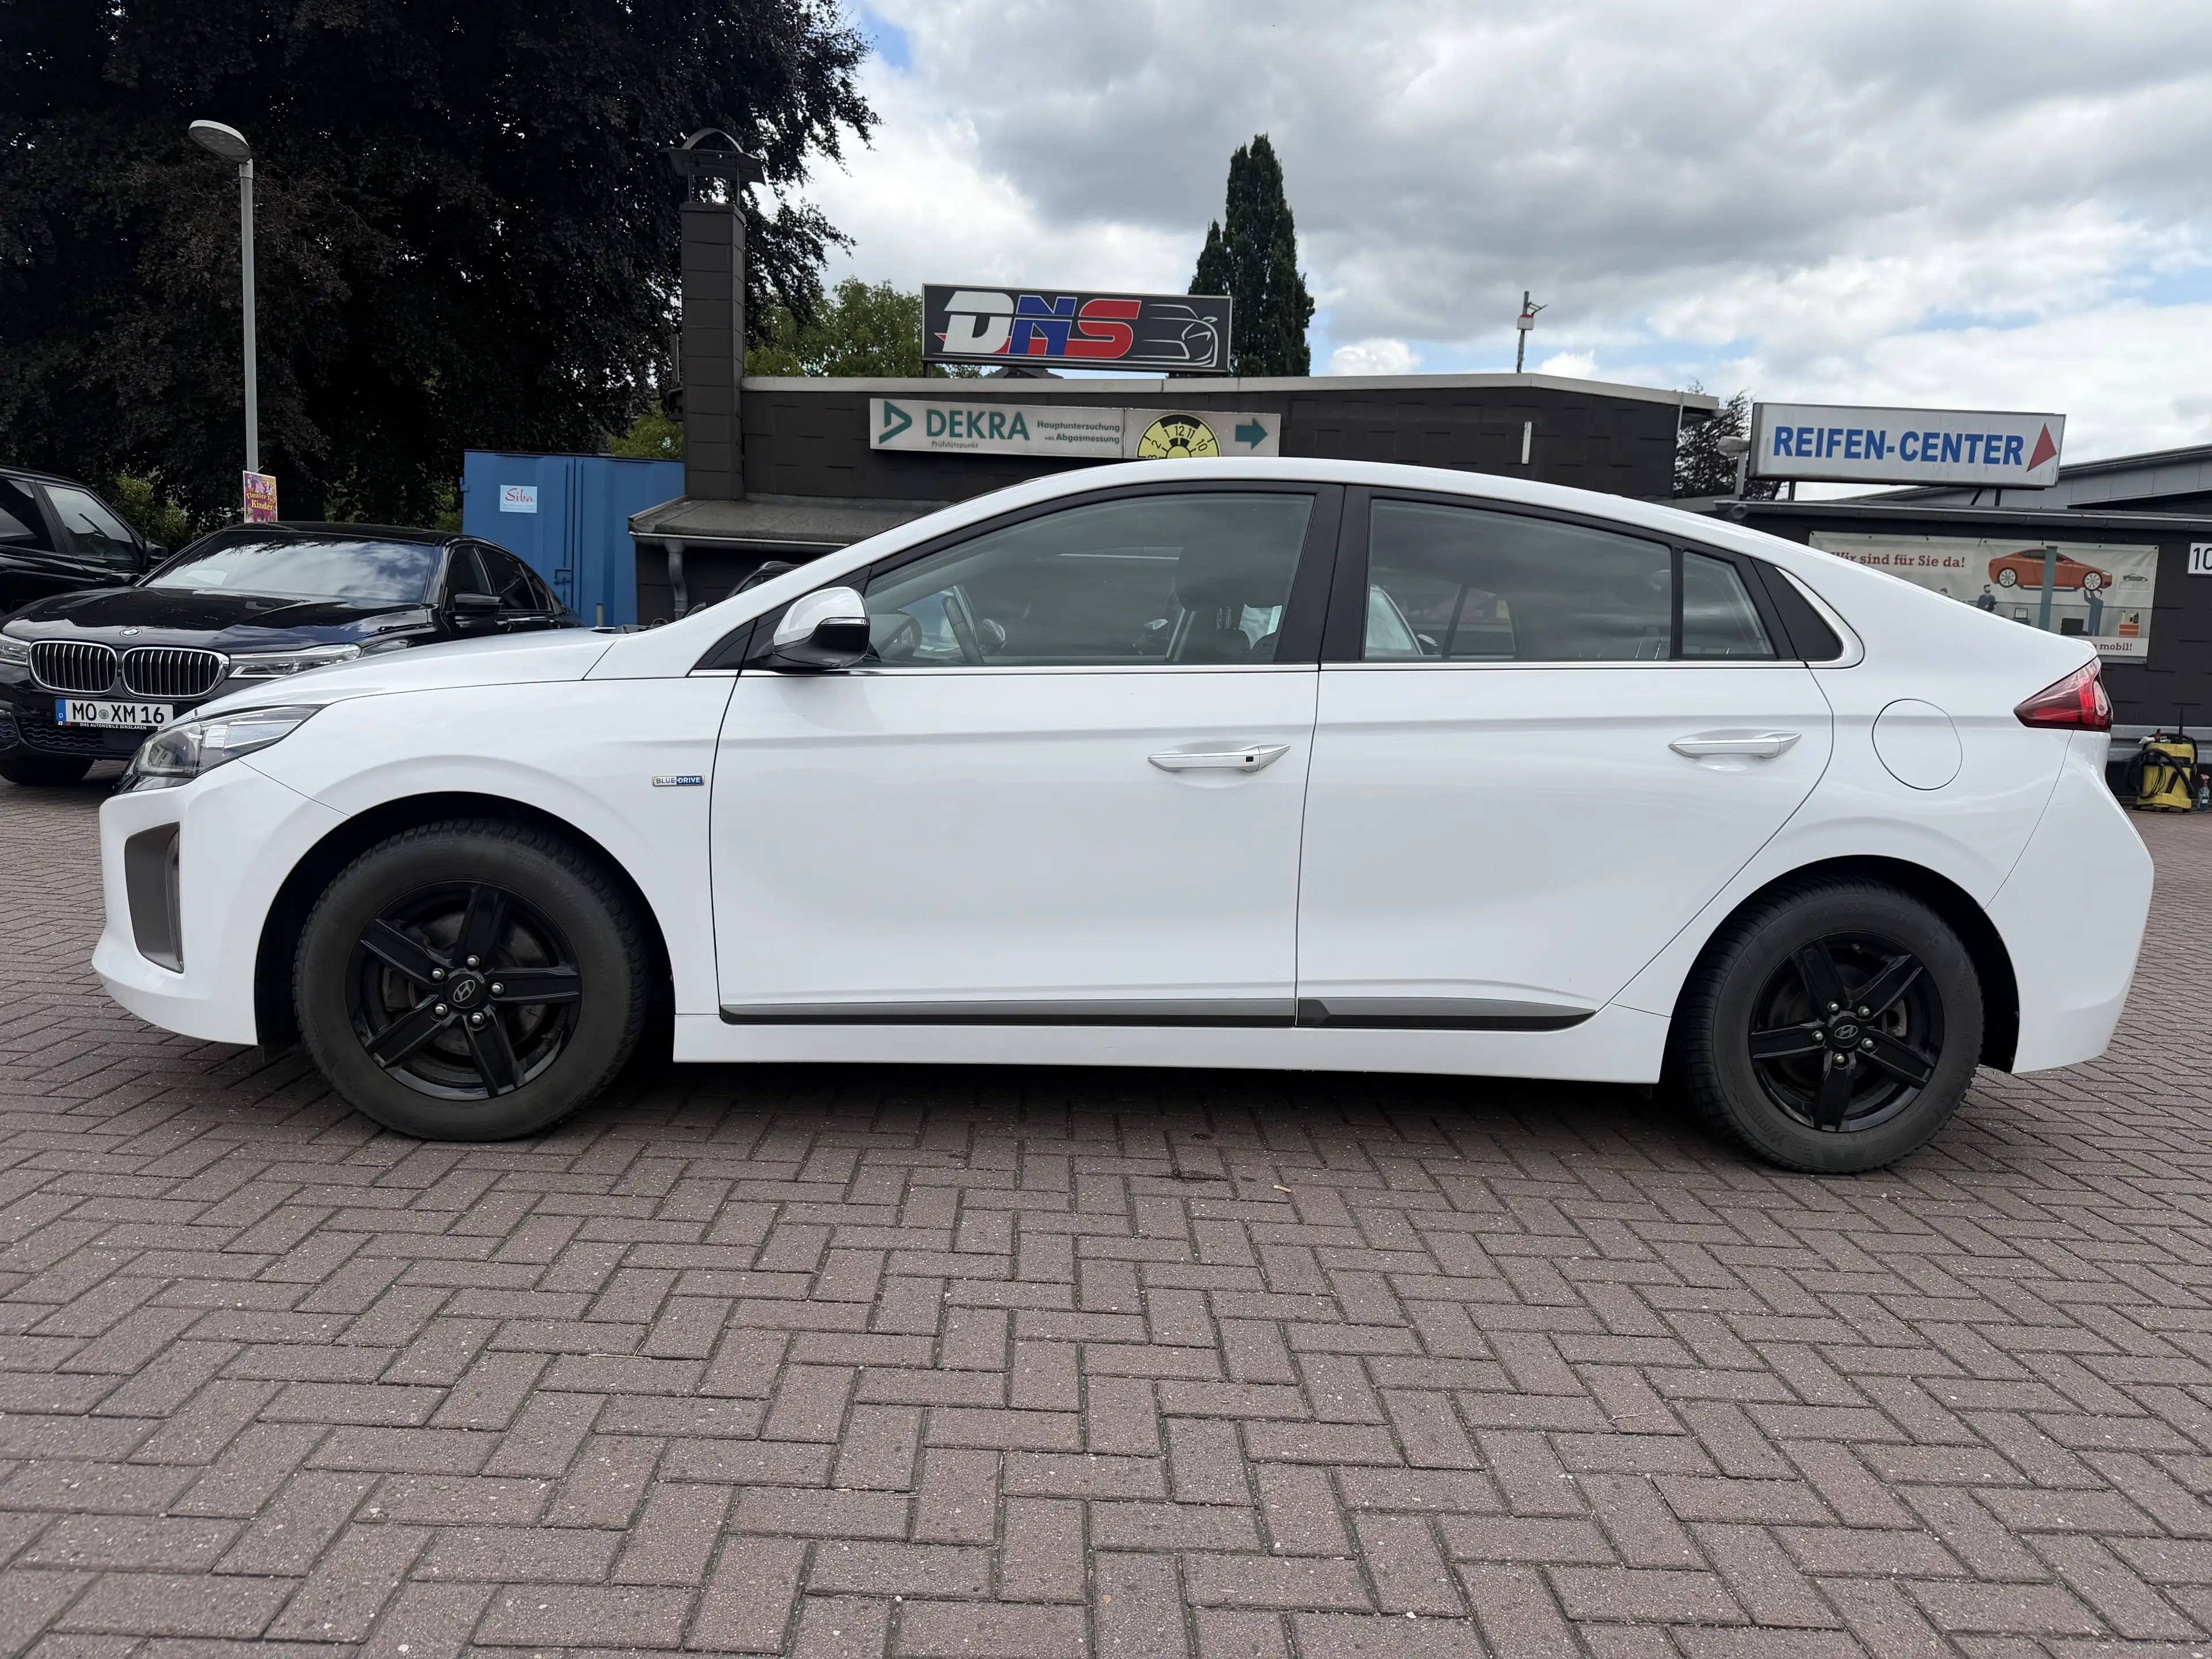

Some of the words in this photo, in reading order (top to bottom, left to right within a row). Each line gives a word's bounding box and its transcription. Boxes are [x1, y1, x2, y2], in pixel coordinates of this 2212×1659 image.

[943, 291, 1141, 358] DNS
[926, 409, 1030, 441] DEKRA
[1037, 421, 1120, 432] Hauptuntersuchung
[1164, 429, 1170, 438] 1
[1175, 426, 1184, 437] 12
[1187, 427, 1195, 439] 11
[931, 441, 978, 449] Prüfstützpunkt
[1056, 434, 1120, 444] Abgasmessung
[1151, 440, 1161, 449] 2
[1196, 438, 1208, 452] 10
[1773, 426, 2024, 465] REIFEN-CENTER
[505, 487, 533, 502] Siba
[251, 499, 274, 511] Kinder
[1859, 553, 1889, 565] sind
[1894, 554, 1915, 566] für
[1918, 555, 1938, 566] Sie
[1943, 556, 1965, 567] da!
[2099, 643, 2133, 651] mobil!
[72, 702, 97, 721] MO
[111, 704, 136, 722] XM
[141, 706, 165, 724] 16
